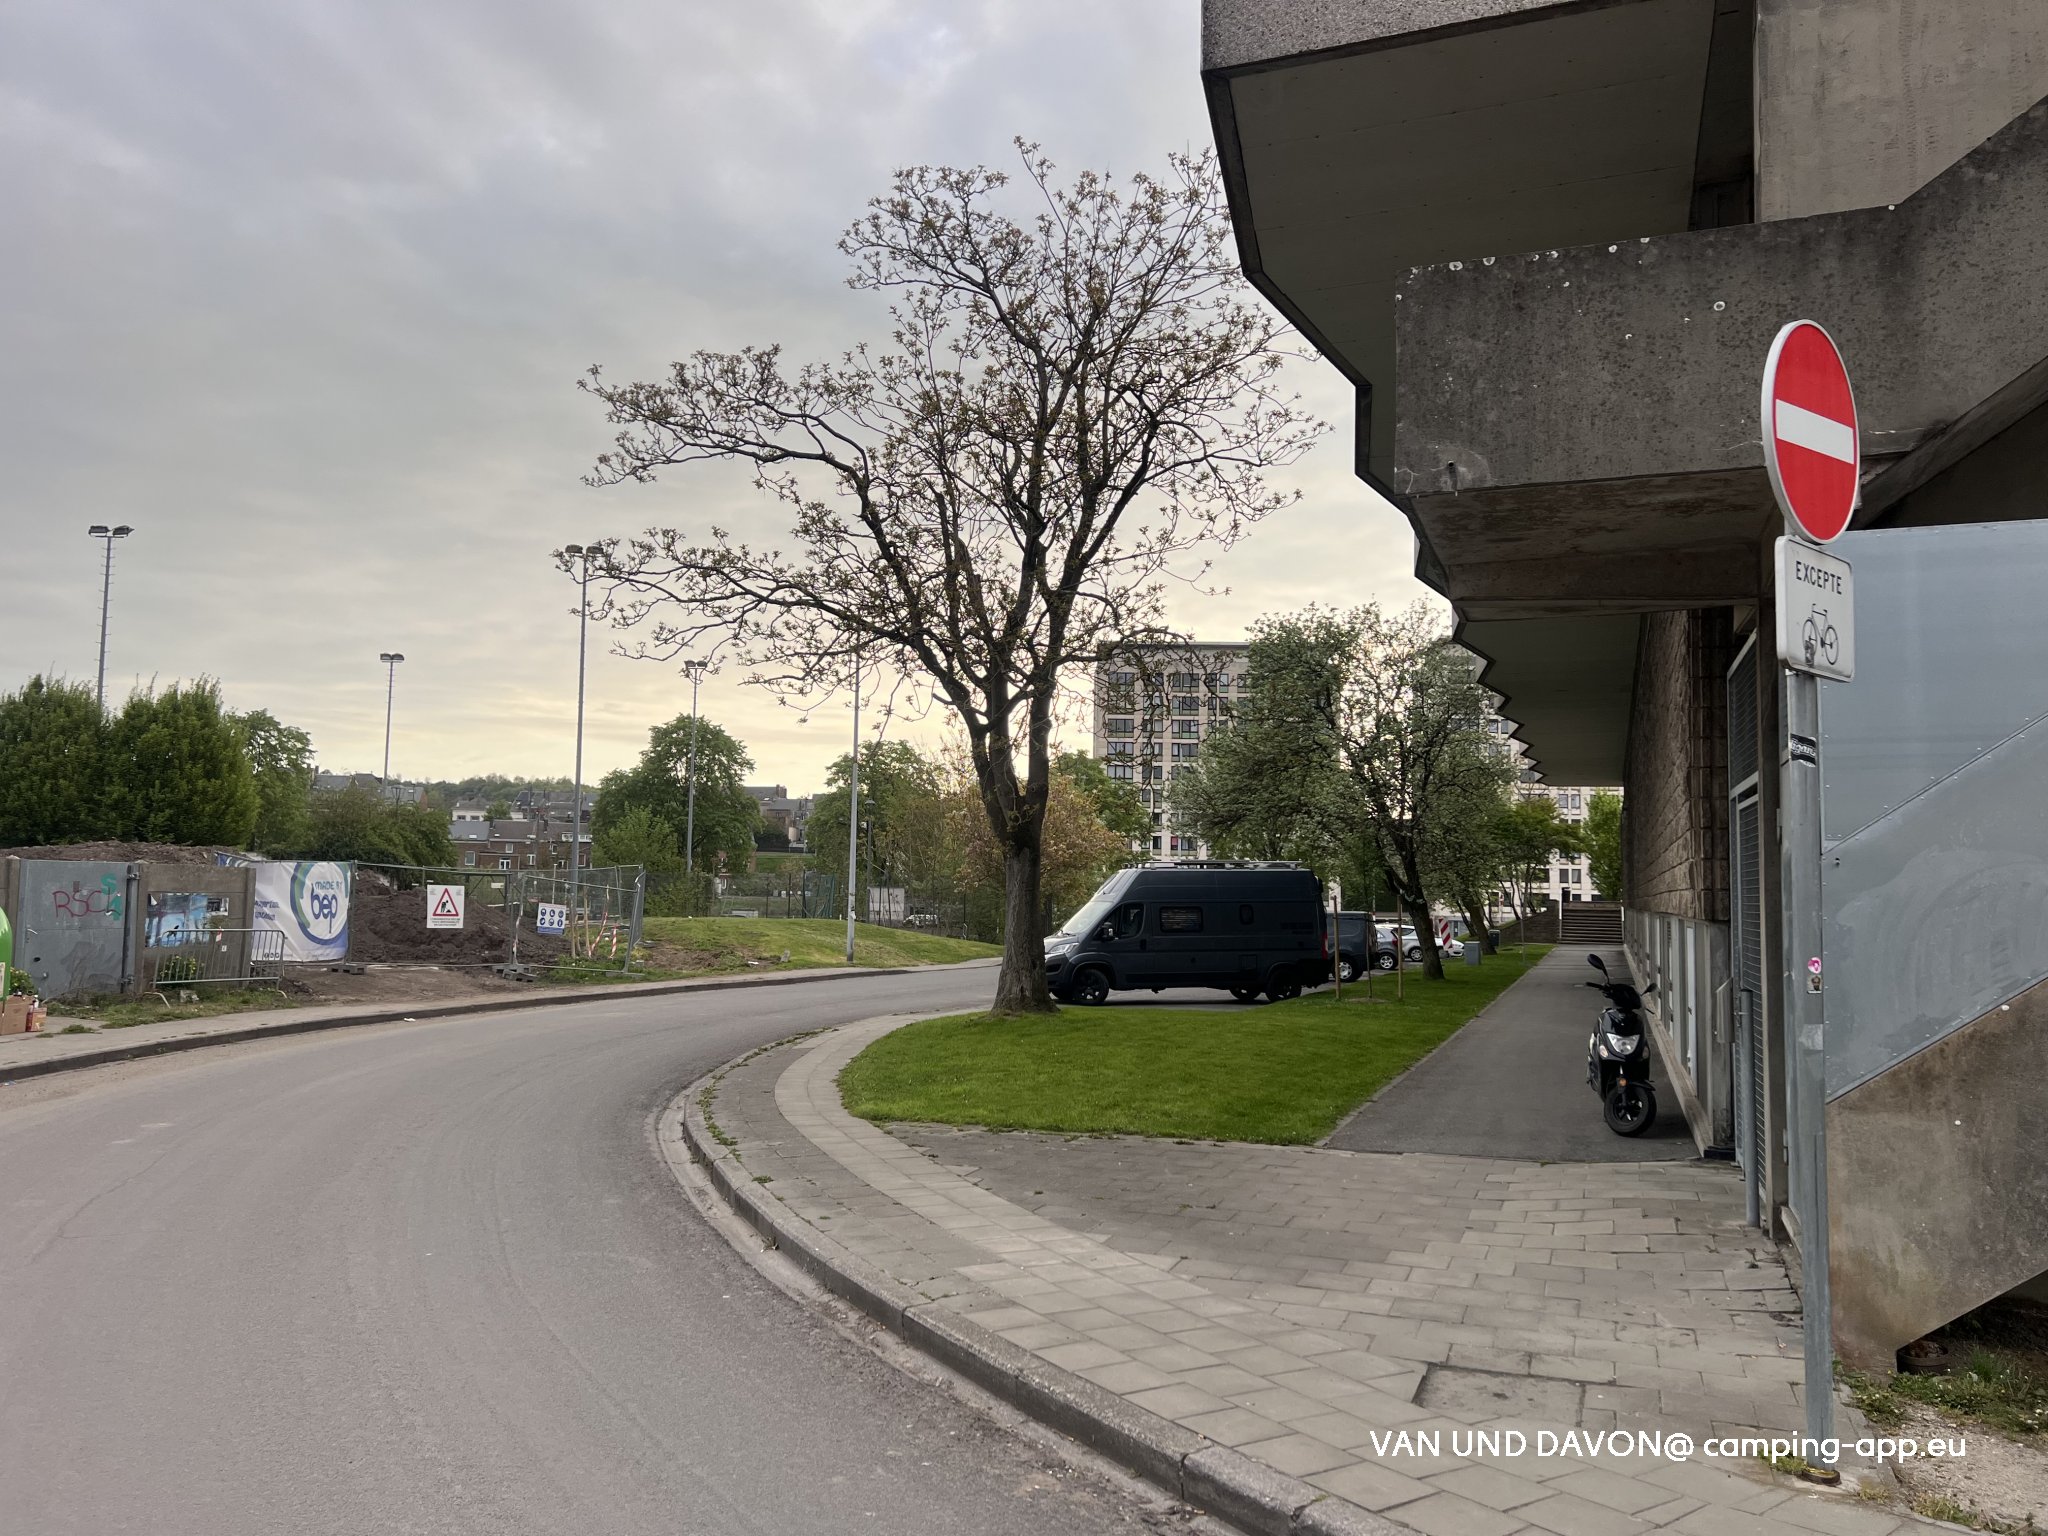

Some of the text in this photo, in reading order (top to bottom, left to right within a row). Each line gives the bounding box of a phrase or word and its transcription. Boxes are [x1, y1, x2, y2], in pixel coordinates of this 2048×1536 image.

[1795, 560, 1842, 595] EXCEPTE
[314, 881, 335, 891] MADE
[310, 883, 338, 934] bep
